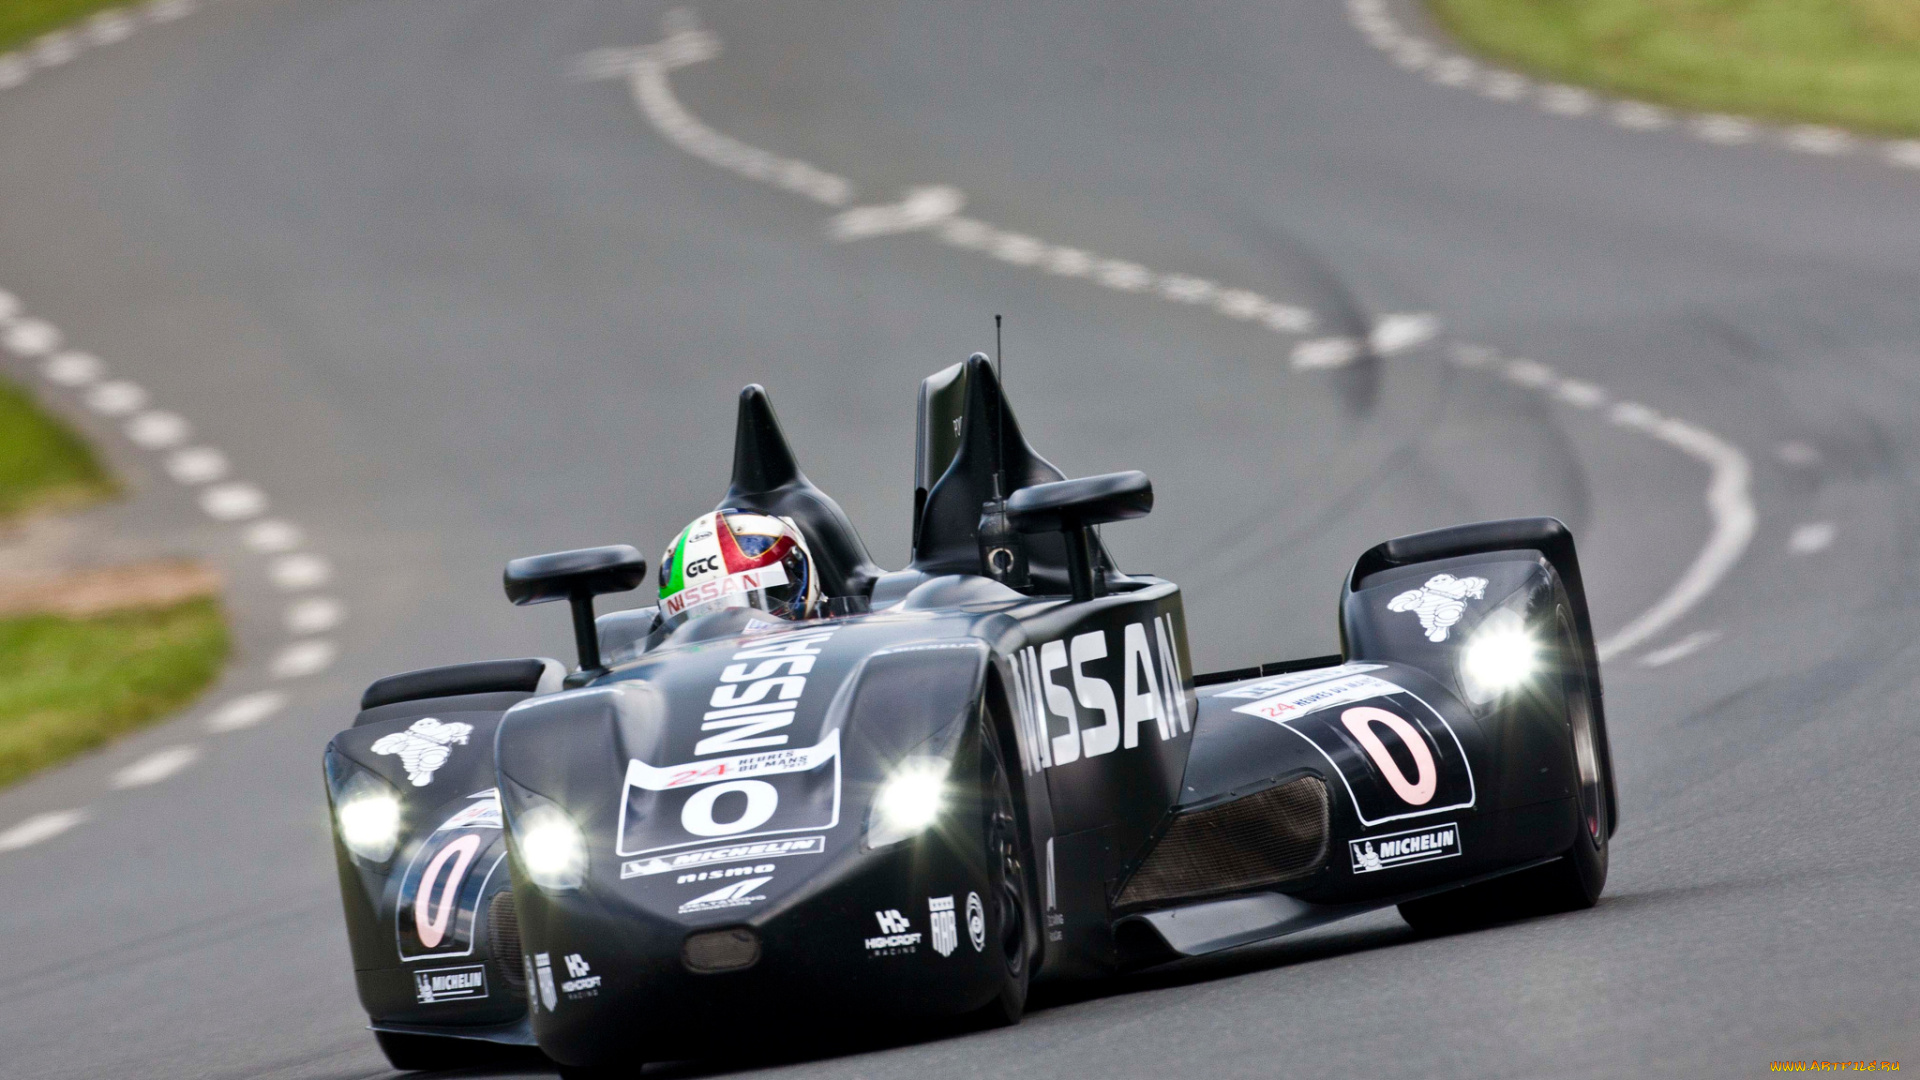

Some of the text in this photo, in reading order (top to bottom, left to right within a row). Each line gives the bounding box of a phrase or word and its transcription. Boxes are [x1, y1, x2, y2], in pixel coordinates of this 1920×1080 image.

[686, 555, 719, 578] GTC
[666, 572, 762, 615] NISSAN
[1008, 612, 1190, 776] NISSAN
[1262, 703, 1296, 717] 24
[765, 755, 808, 767] MANS
[666, 764, 734, 787] 24
[673, 839, 816, 866] MICHELIN
[1380, 829, 1454, 859] MICHELIN
[432, 972, 482, 991] MICHELIN
